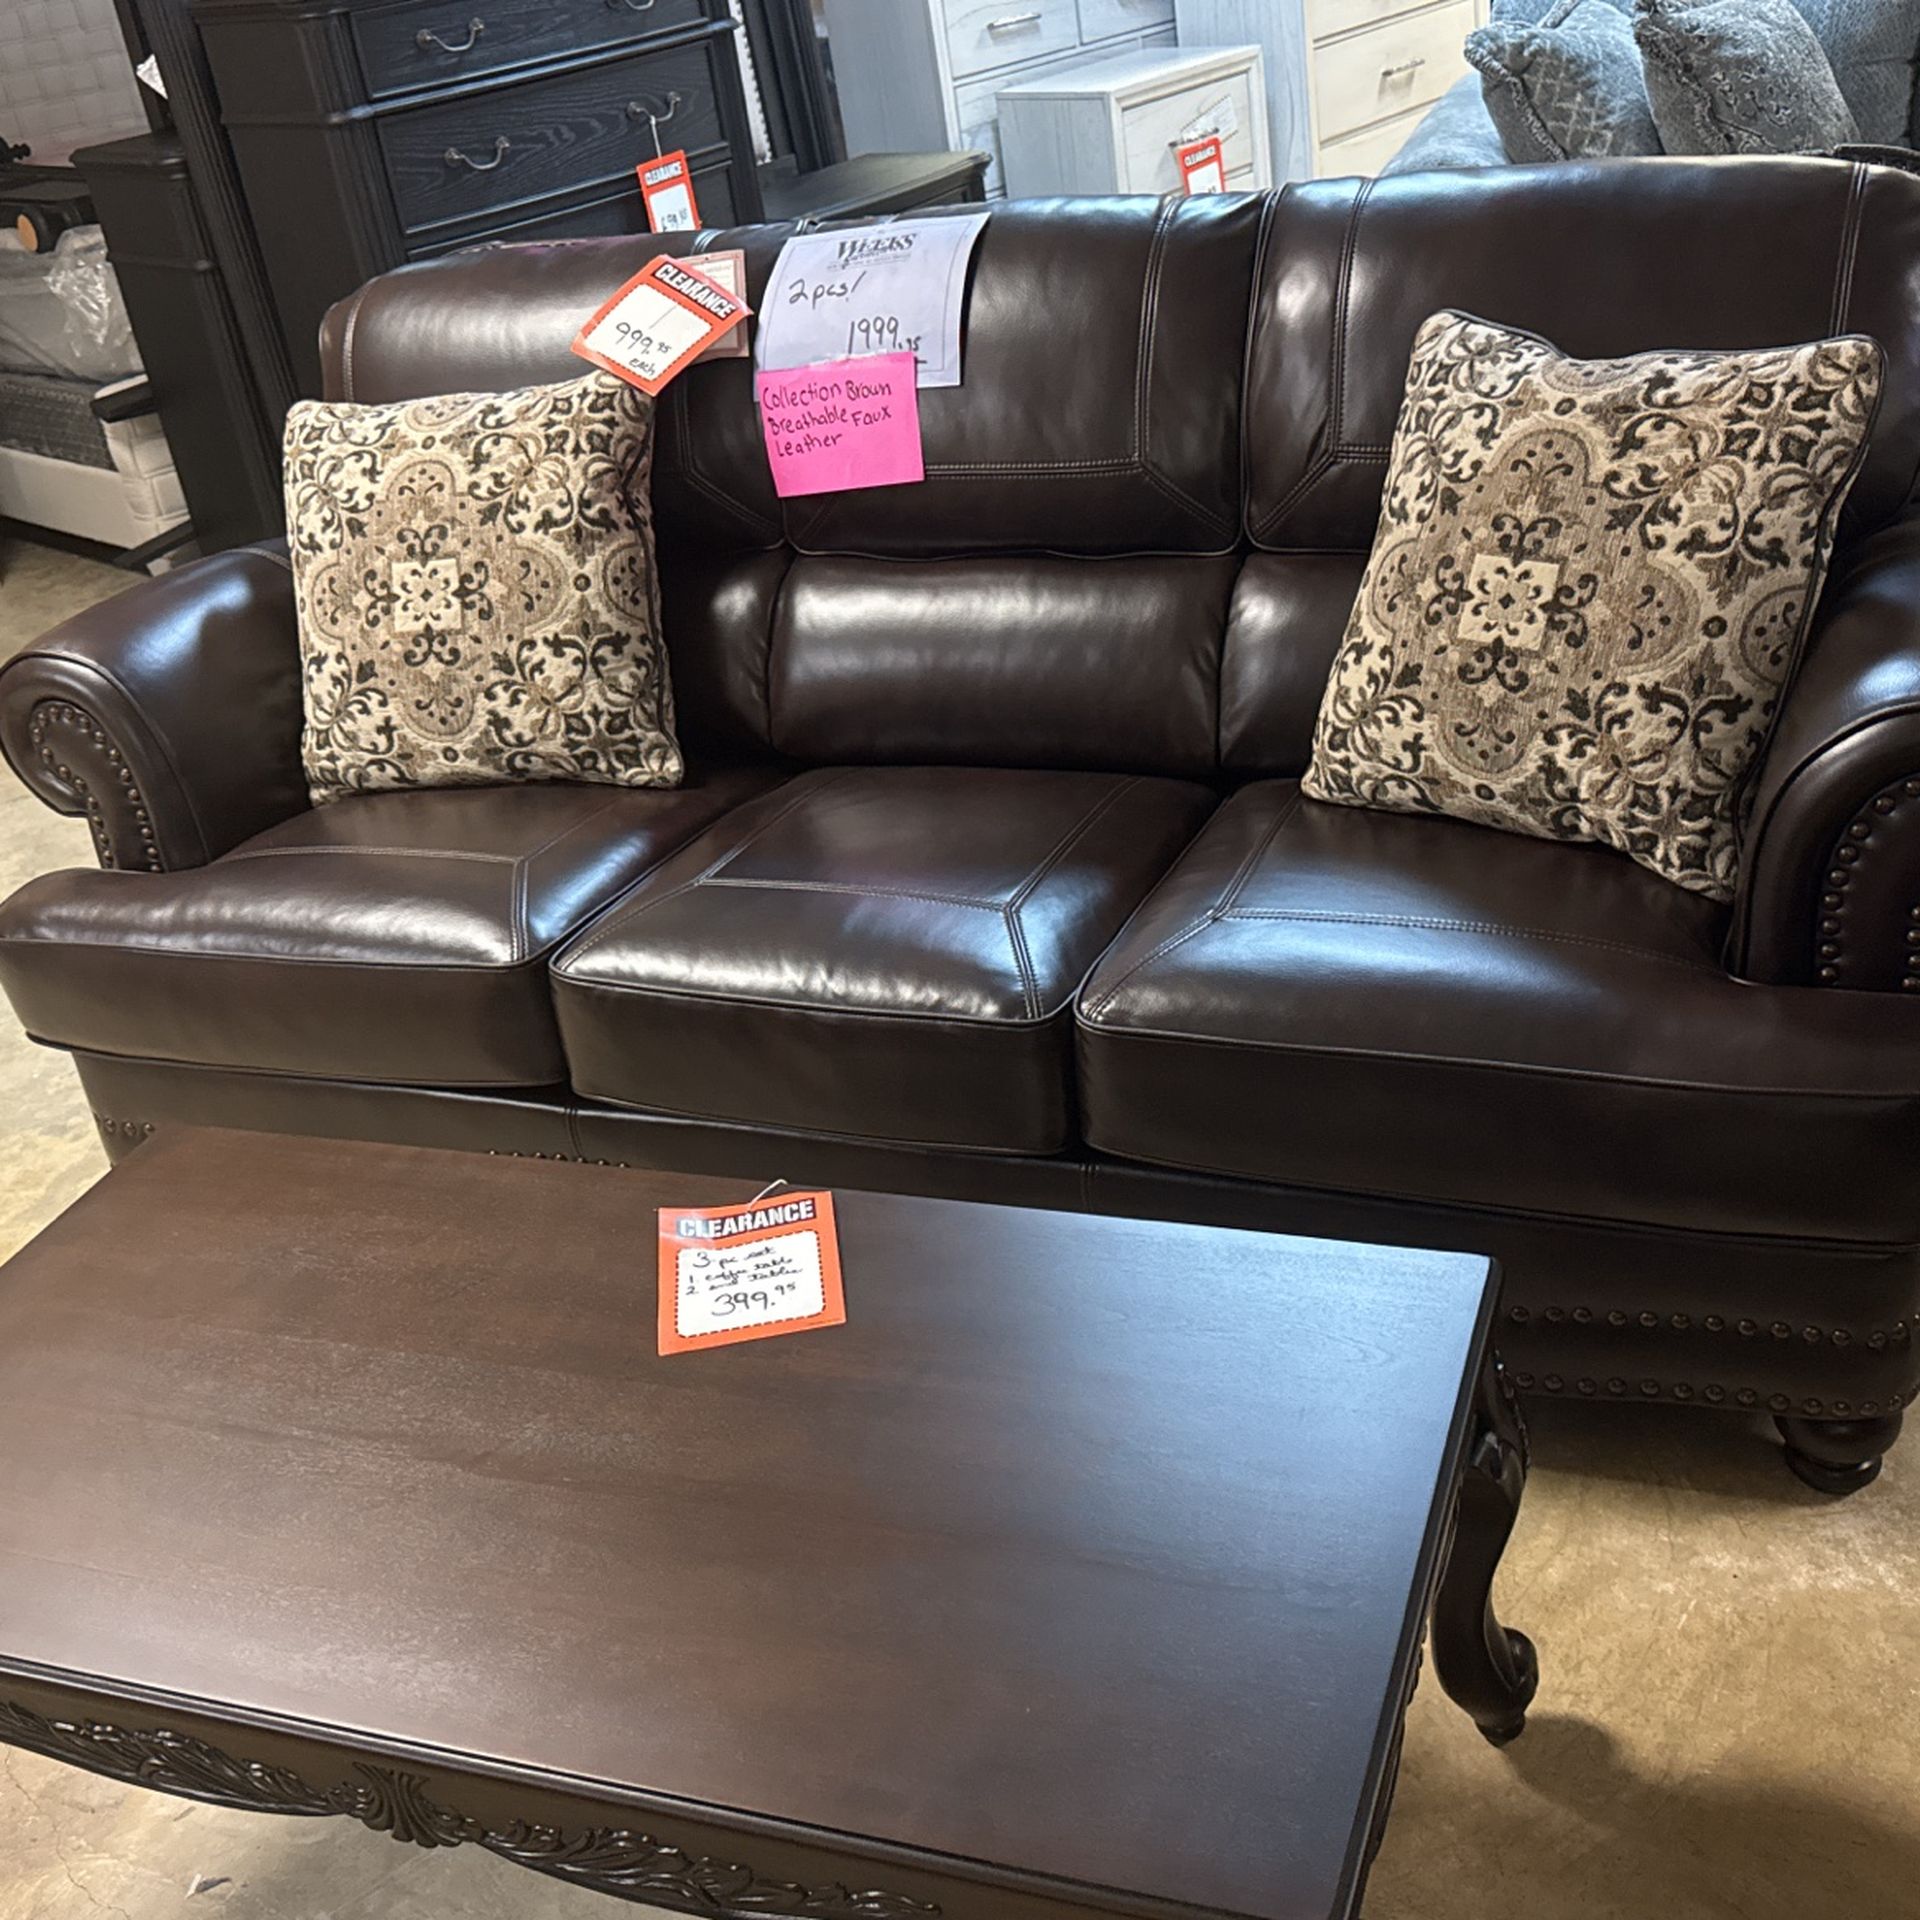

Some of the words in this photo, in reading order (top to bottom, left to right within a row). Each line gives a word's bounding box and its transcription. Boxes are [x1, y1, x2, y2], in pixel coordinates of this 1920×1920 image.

[644, 160, 683, 187] CLEARANCE
[654, 263, 737, 320] CLEARANCE
[763, 383, 842, 411] Collection
[767, 405, 848, 436] Breathable
[851, 405, 892, 426] Faux
[776, 433, 842, 457] Leather
[678, 1199, 814, 1239] CLEARANCE
